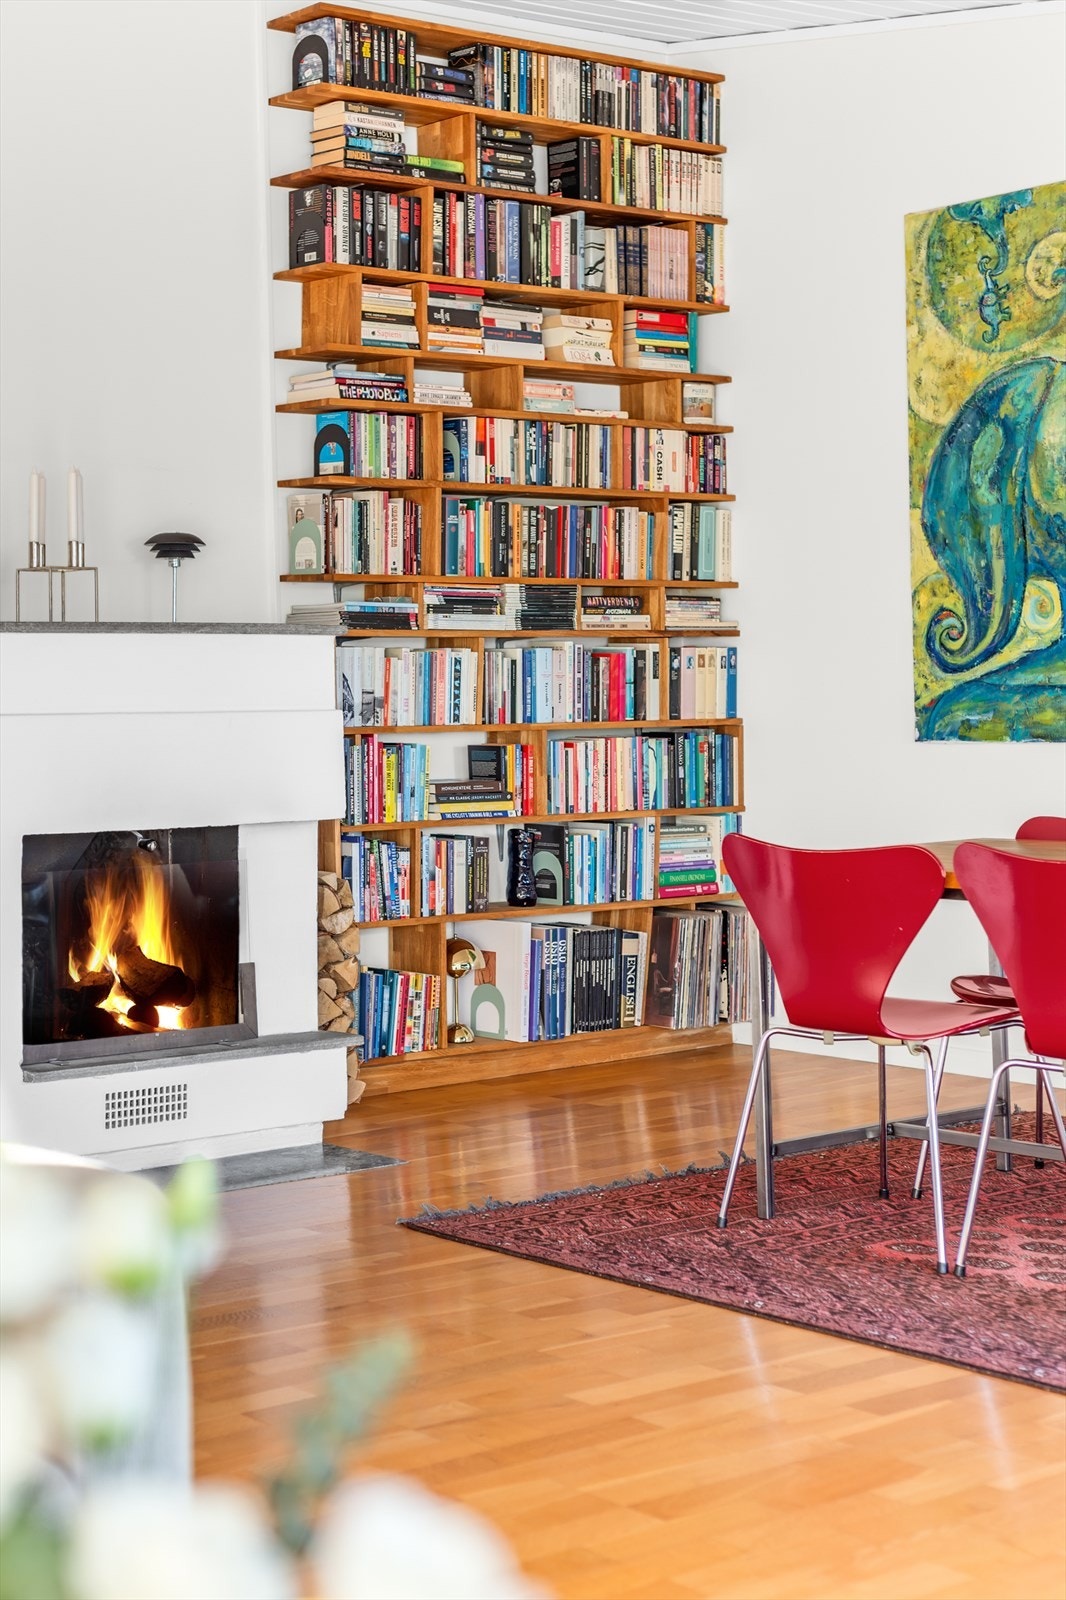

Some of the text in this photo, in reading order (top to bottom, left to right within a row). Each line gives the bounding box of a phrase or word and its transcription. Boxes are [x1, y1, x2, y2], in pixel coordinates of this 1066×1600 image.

[377, 130, 393, 139] HOLT
[433, 203, 443, 212] JO
[467, 194, 476, 210] JOHN
[467, 210, 476, 234] GRISHAM
[376, 330, 402, 339] Sapiens
[673, 511, 684, 553] PAPILLON
[559, 940, 567, 963] OSLO
[625, 957, 636, 1016] ENGLISH
